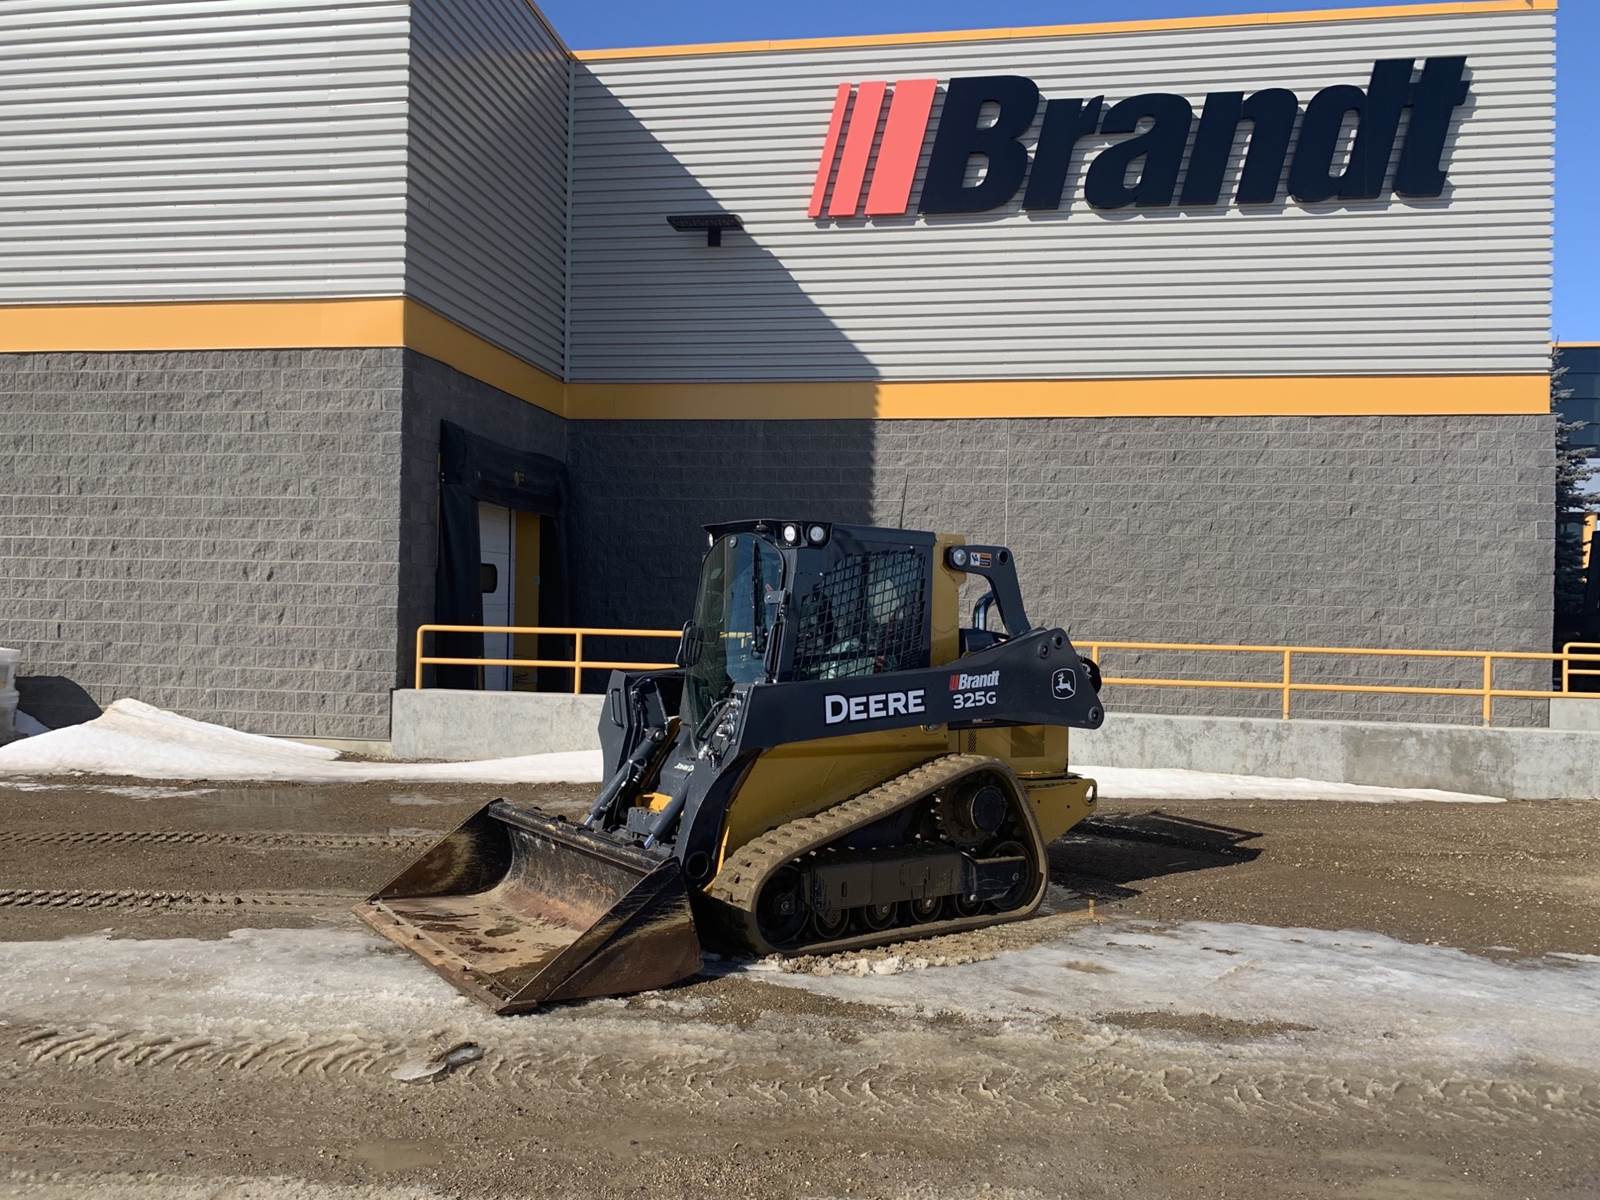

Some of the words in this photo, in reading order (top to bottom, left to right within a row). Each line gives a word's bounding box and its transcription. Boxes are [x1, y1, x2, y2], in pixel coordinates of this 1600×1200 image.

[918, 56, 1470, 214] Brandt
[959, 670, 1000, 690] Brandt
[825, 689, 925, 724] DEERE
[952, 691, 997, 710] 325G
